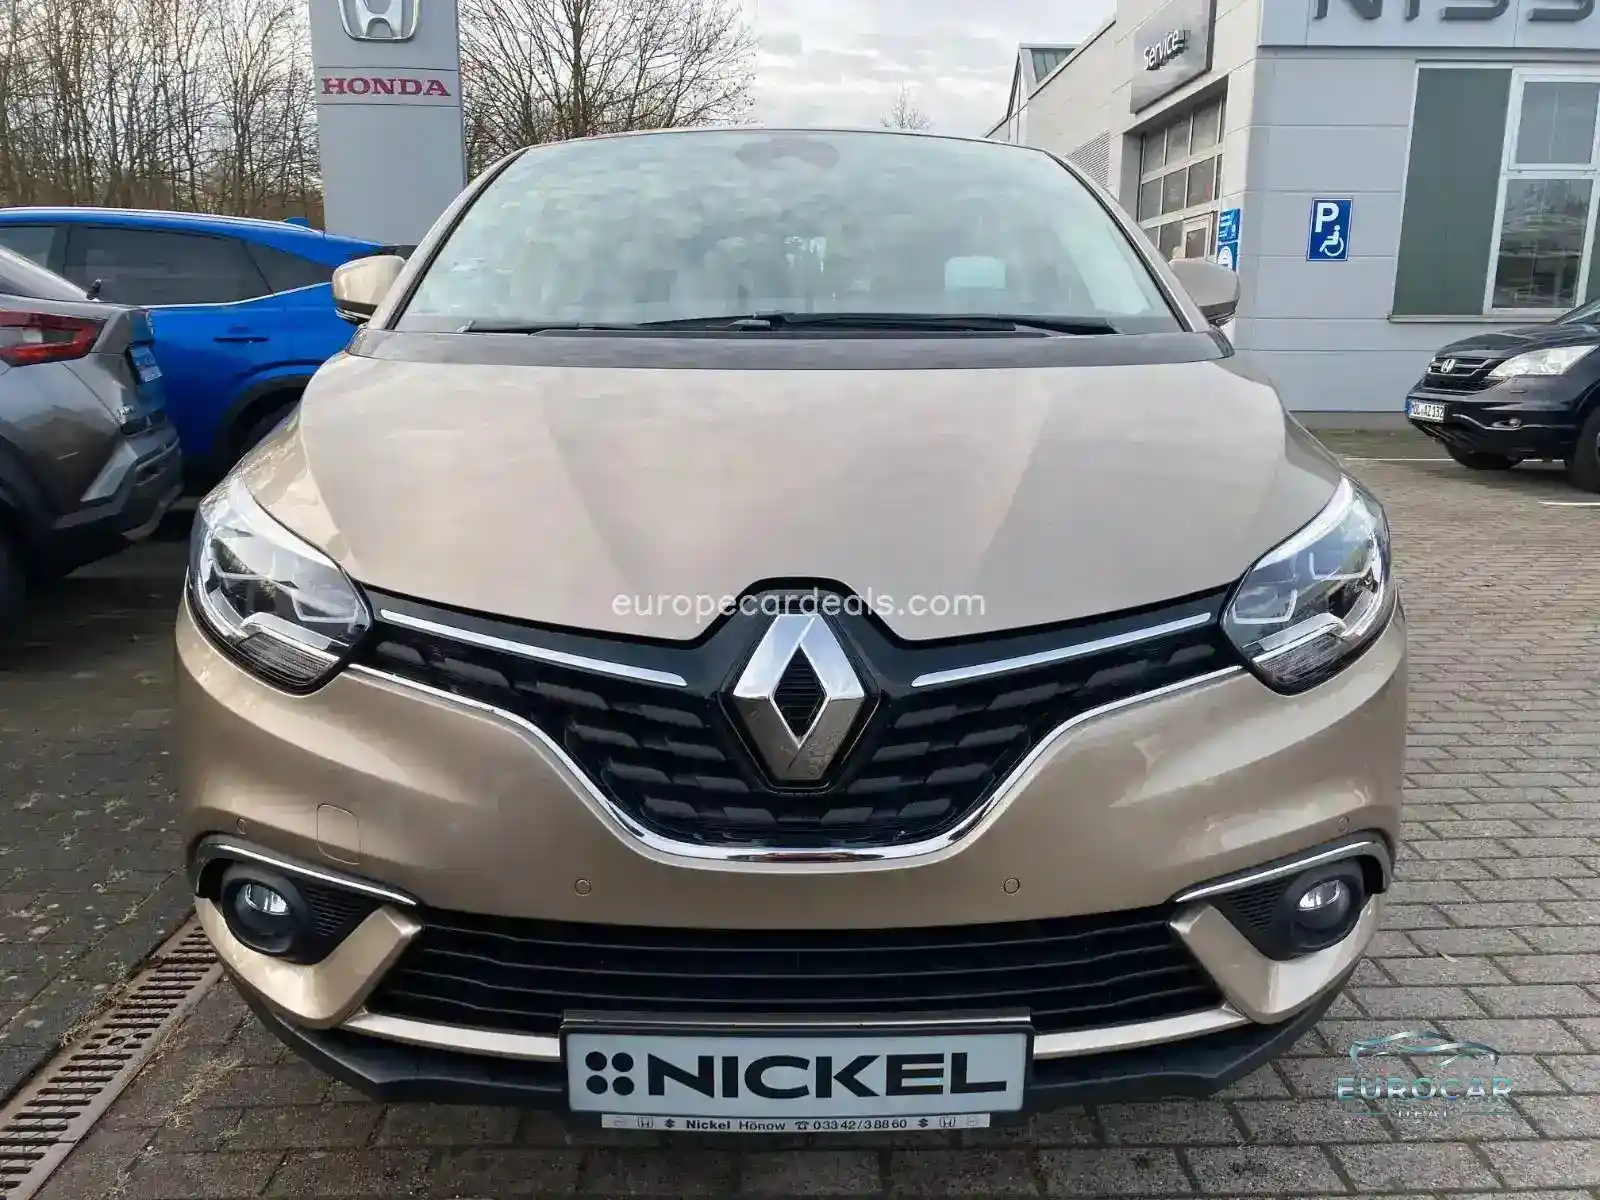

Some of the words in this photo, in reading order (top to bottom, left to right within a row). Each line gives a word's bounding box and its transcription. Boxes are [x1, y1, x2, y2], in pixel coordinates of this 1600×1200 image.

[1143, 28, 1185, 71] Service
[320, 77, 451, 97] HONDA
[1314, 202, 1340, 233] P
[647, 1052, 1007, 1099] NICKEL
[686, 1118, 731, 1131] Nickel
[739, 1119, 786, 1131] Hönow
